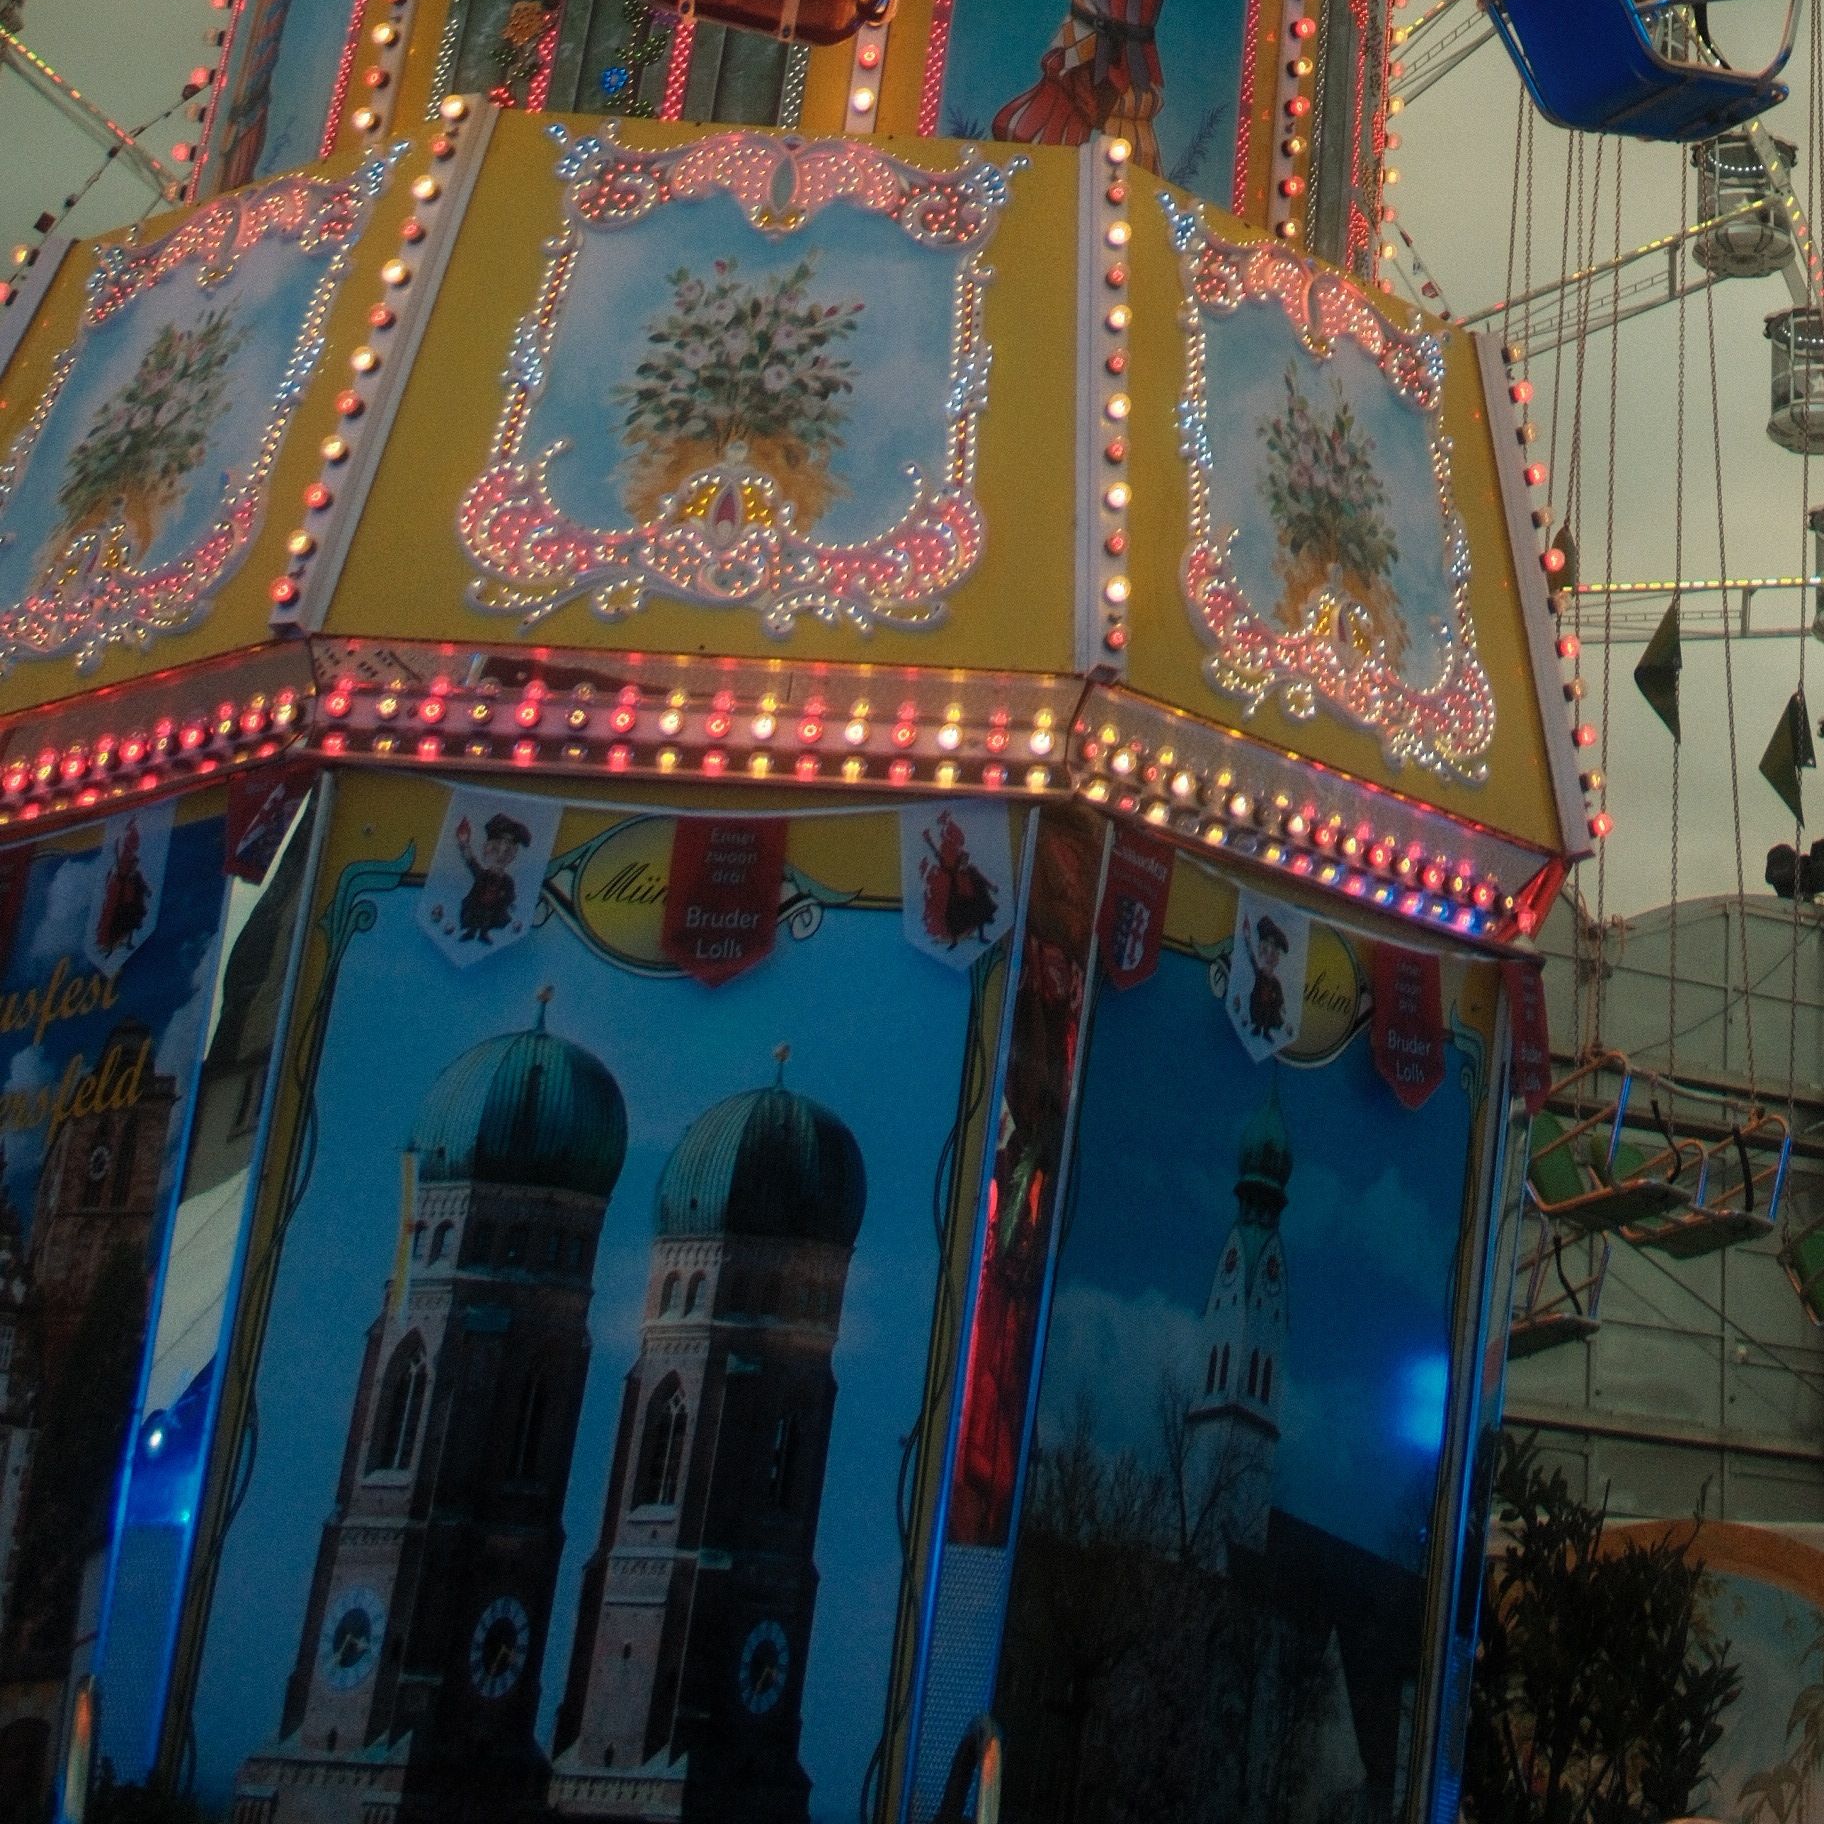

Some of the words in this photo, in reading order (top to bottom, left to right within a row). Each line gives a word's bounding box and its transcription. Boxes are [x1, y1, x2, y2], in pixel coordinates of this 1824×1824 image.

[685, 905, 761, 929] Bruder
[695, 936, 744, 960] Lolls
[1304, 970, 1352, 1014] heim
[1388, 1028, 1432, 1057] Bruder
